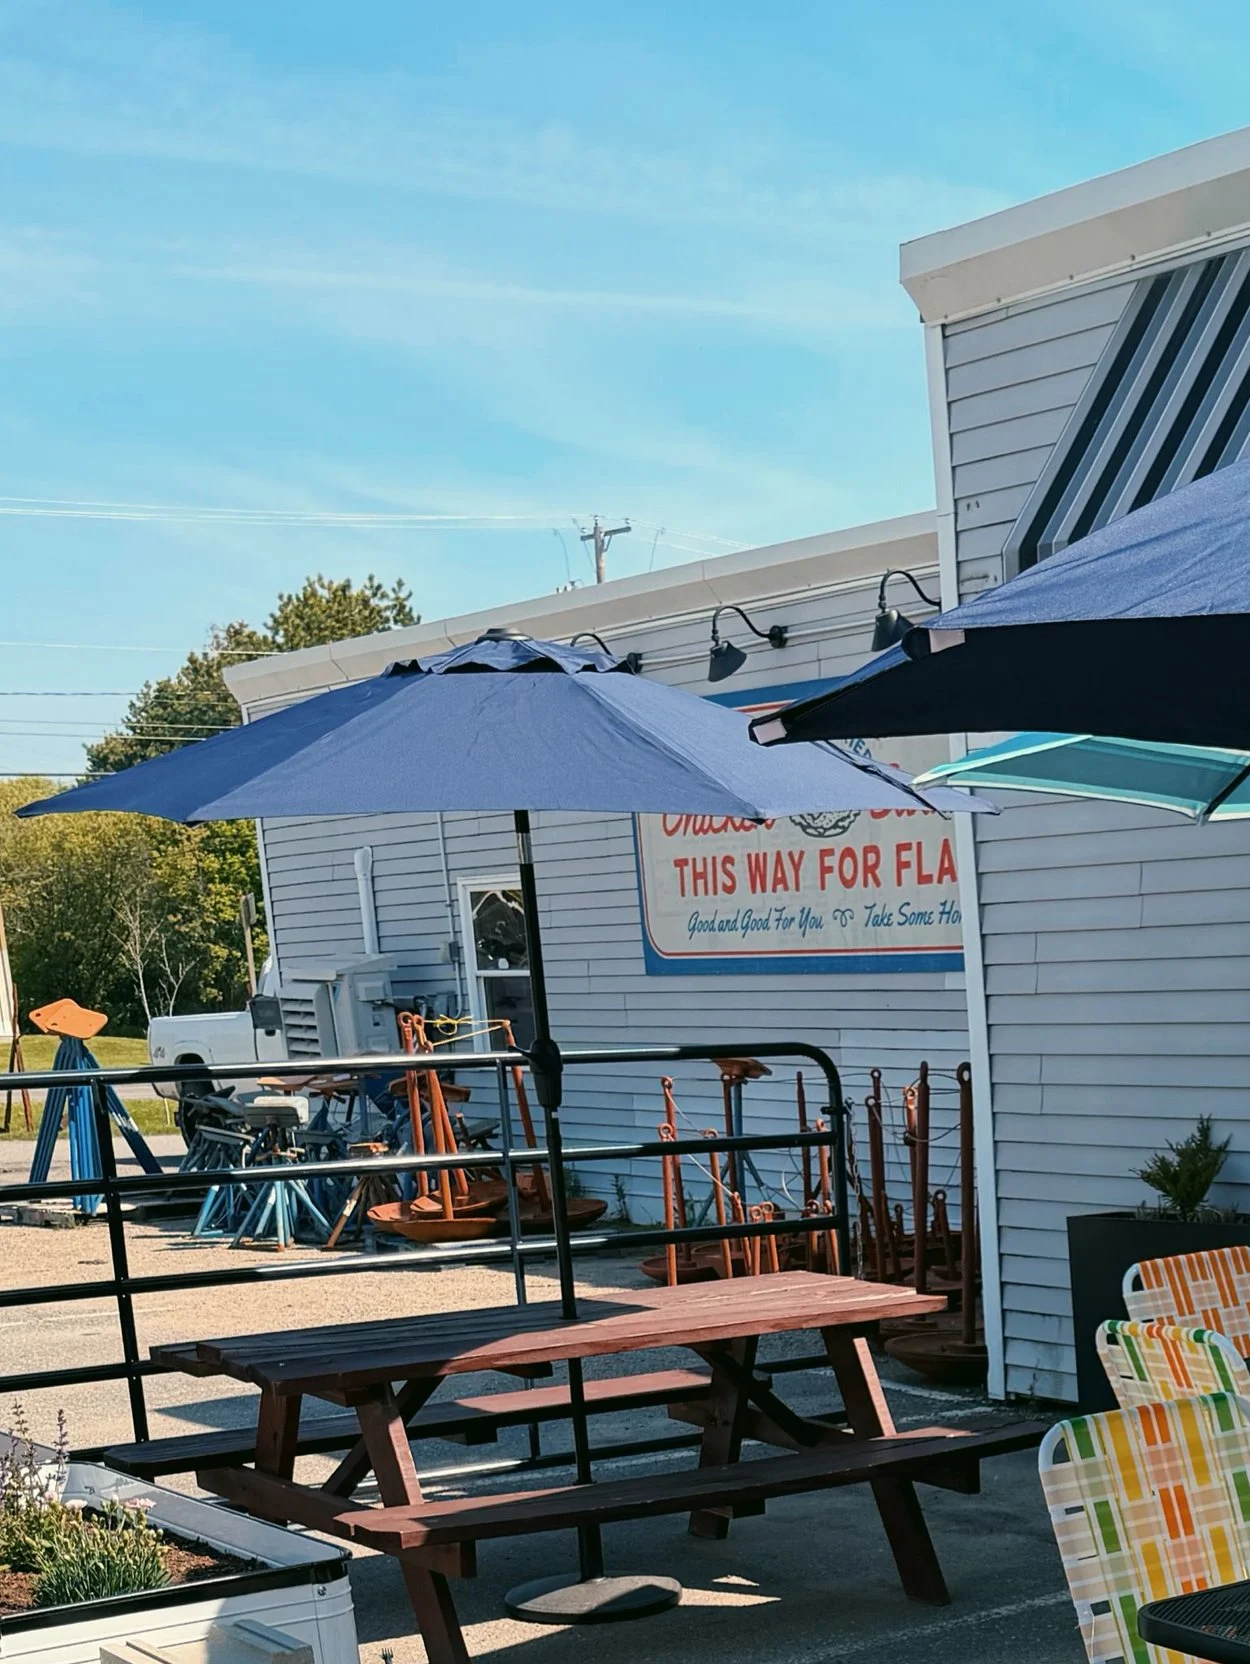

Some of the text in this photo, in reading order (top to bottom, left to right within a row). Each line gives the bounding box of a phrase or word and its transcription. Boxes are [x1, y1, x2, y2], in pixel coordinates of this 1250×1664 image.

[674, 856, 736, 897] THIS
[747, 850, 805, 894] WAY
[819, 845, 881, 891] FOR
[688, 899, 961, 940] Good and Good For You Take Some Ho
